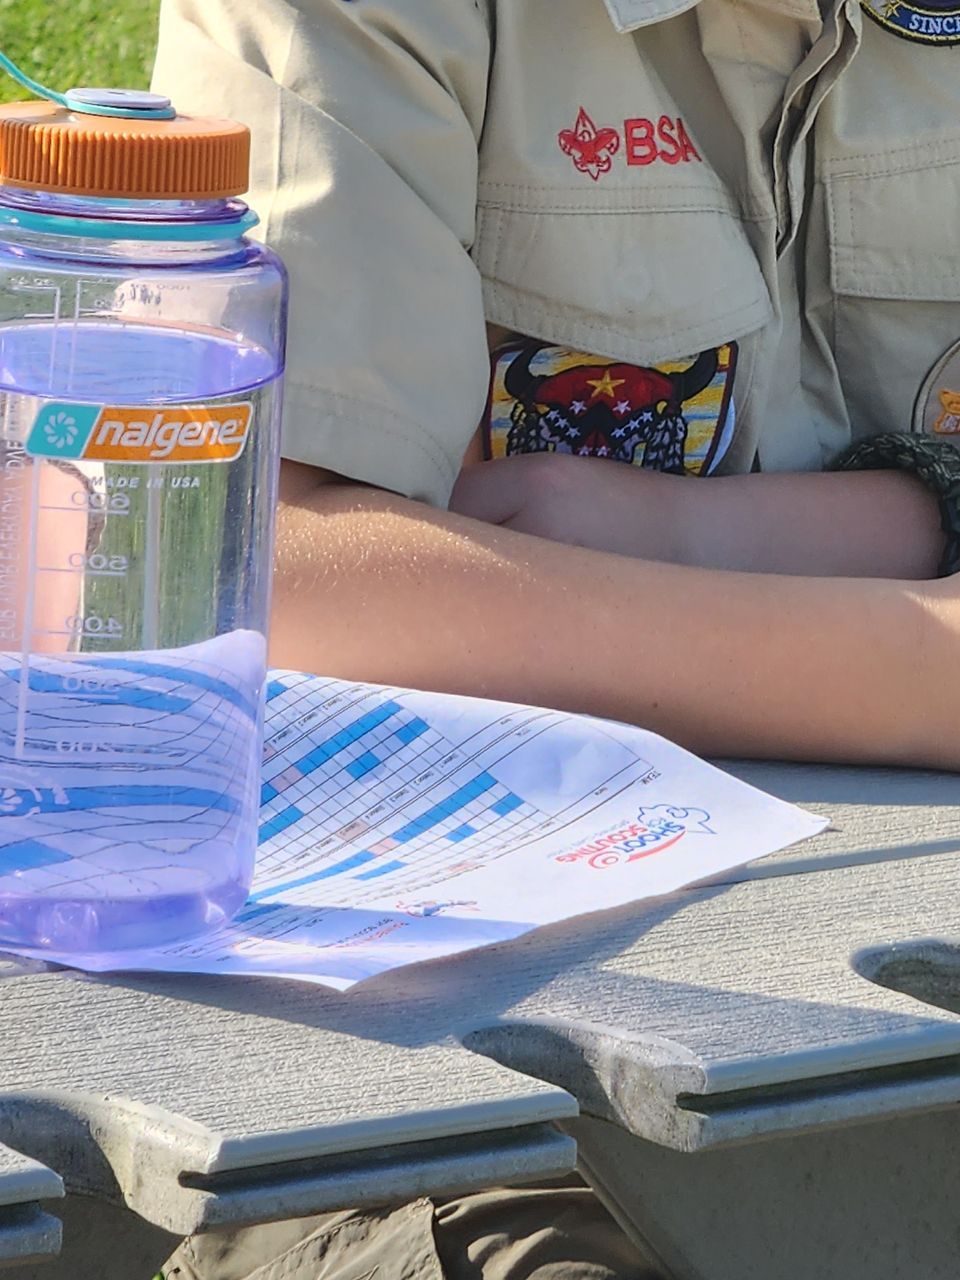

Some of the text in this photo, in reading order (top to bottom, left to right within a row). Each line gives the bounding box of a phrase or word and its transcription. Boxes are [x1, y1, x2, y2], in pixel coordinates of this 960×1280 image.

[624, 115, 703, 166] BSA
[95, 414, 246, 458] nalgene
[90, 477, 138, 490] MADE
[171, 477, 200, 488] USA
[555, 824, 648, 863] SCOUTING
[613, 821, 686, 853] SHOOT
